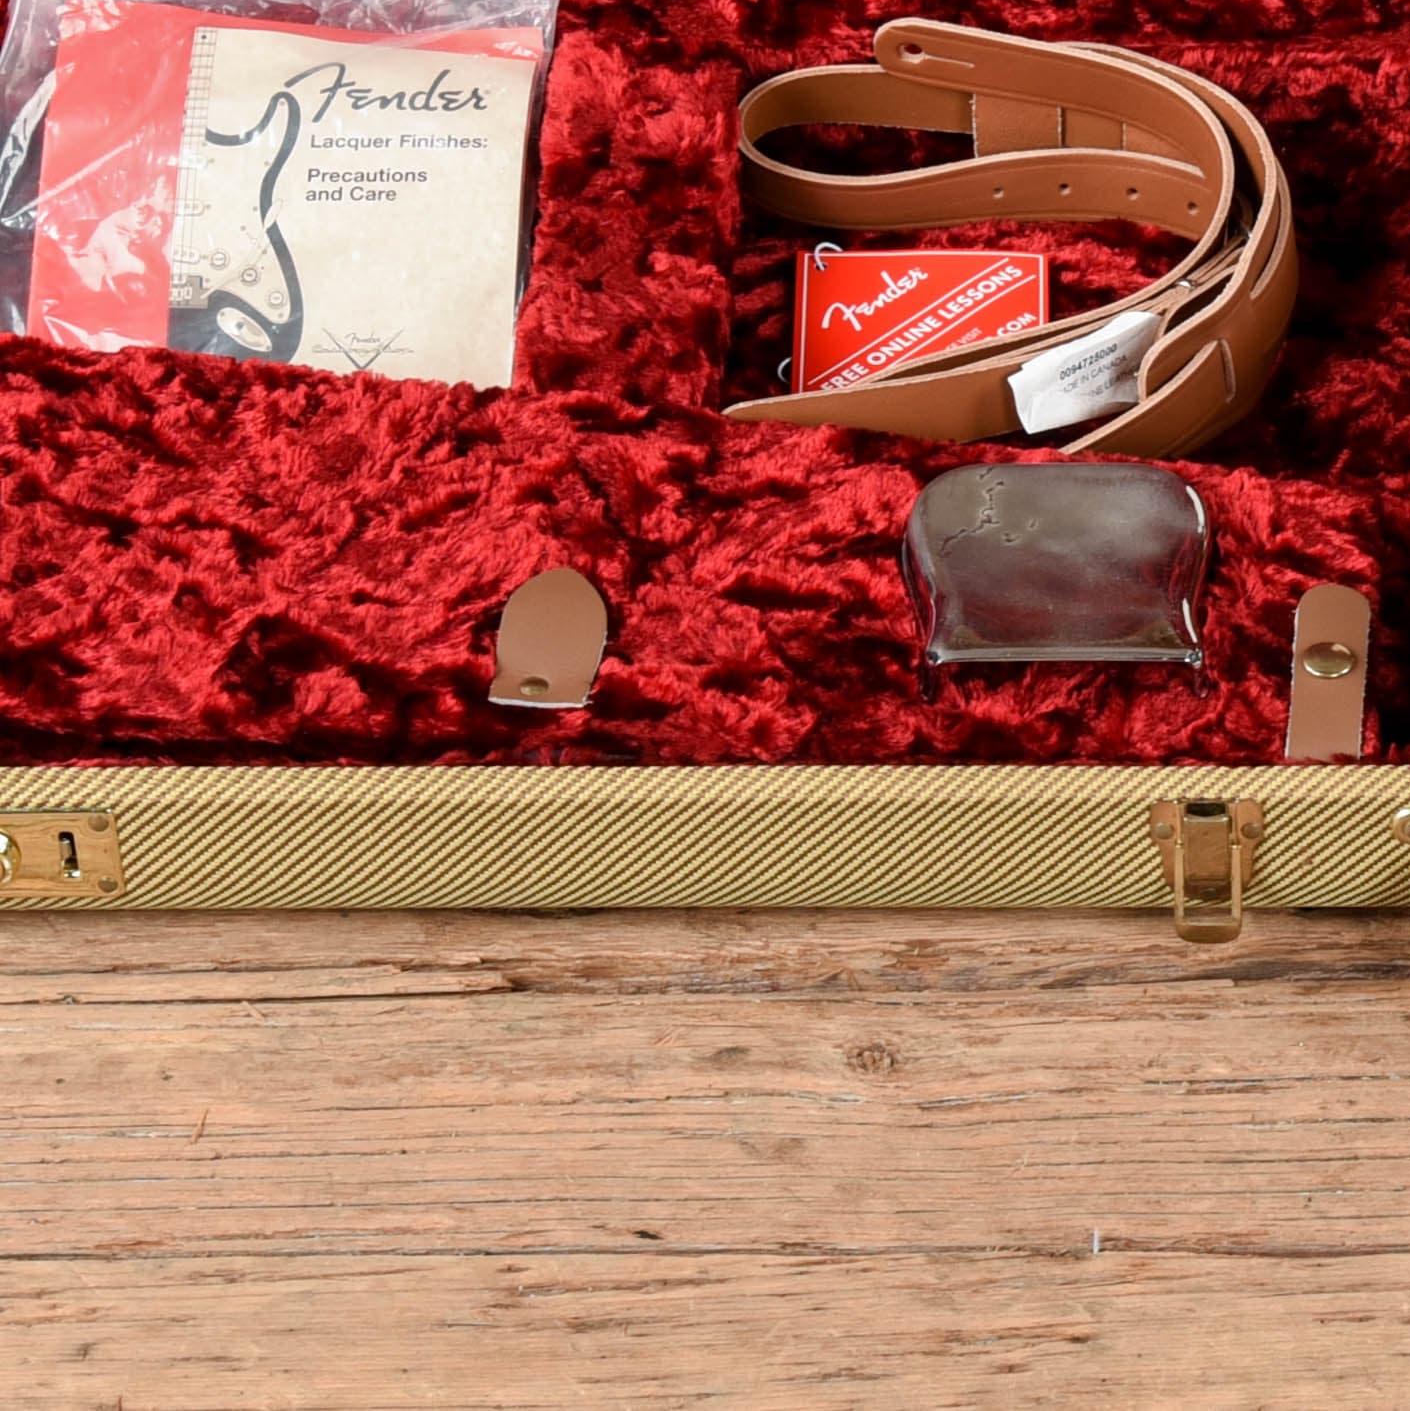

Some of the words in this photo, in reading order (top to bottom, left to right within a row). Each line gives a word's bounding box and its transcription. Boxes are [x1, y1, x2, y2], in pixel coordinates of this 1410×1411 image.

[284, 62, 491, 123] Fender
[310, 134, 393, 152] Lacquer
[398, 134, 489, 150] Finishes:
[307, 167, 428, 184] Precautions
[305, 185, 344, 202] and
[349, 185, 397, 202] Care
[820, 267, 929, 331] Fender
[820, 362, 869, 391] FREE
[866, 315, 943, 366] ONLINE
[937, 264, 1023, 320] LESSONS
[1091, 355, 1128, 379] CANADA
